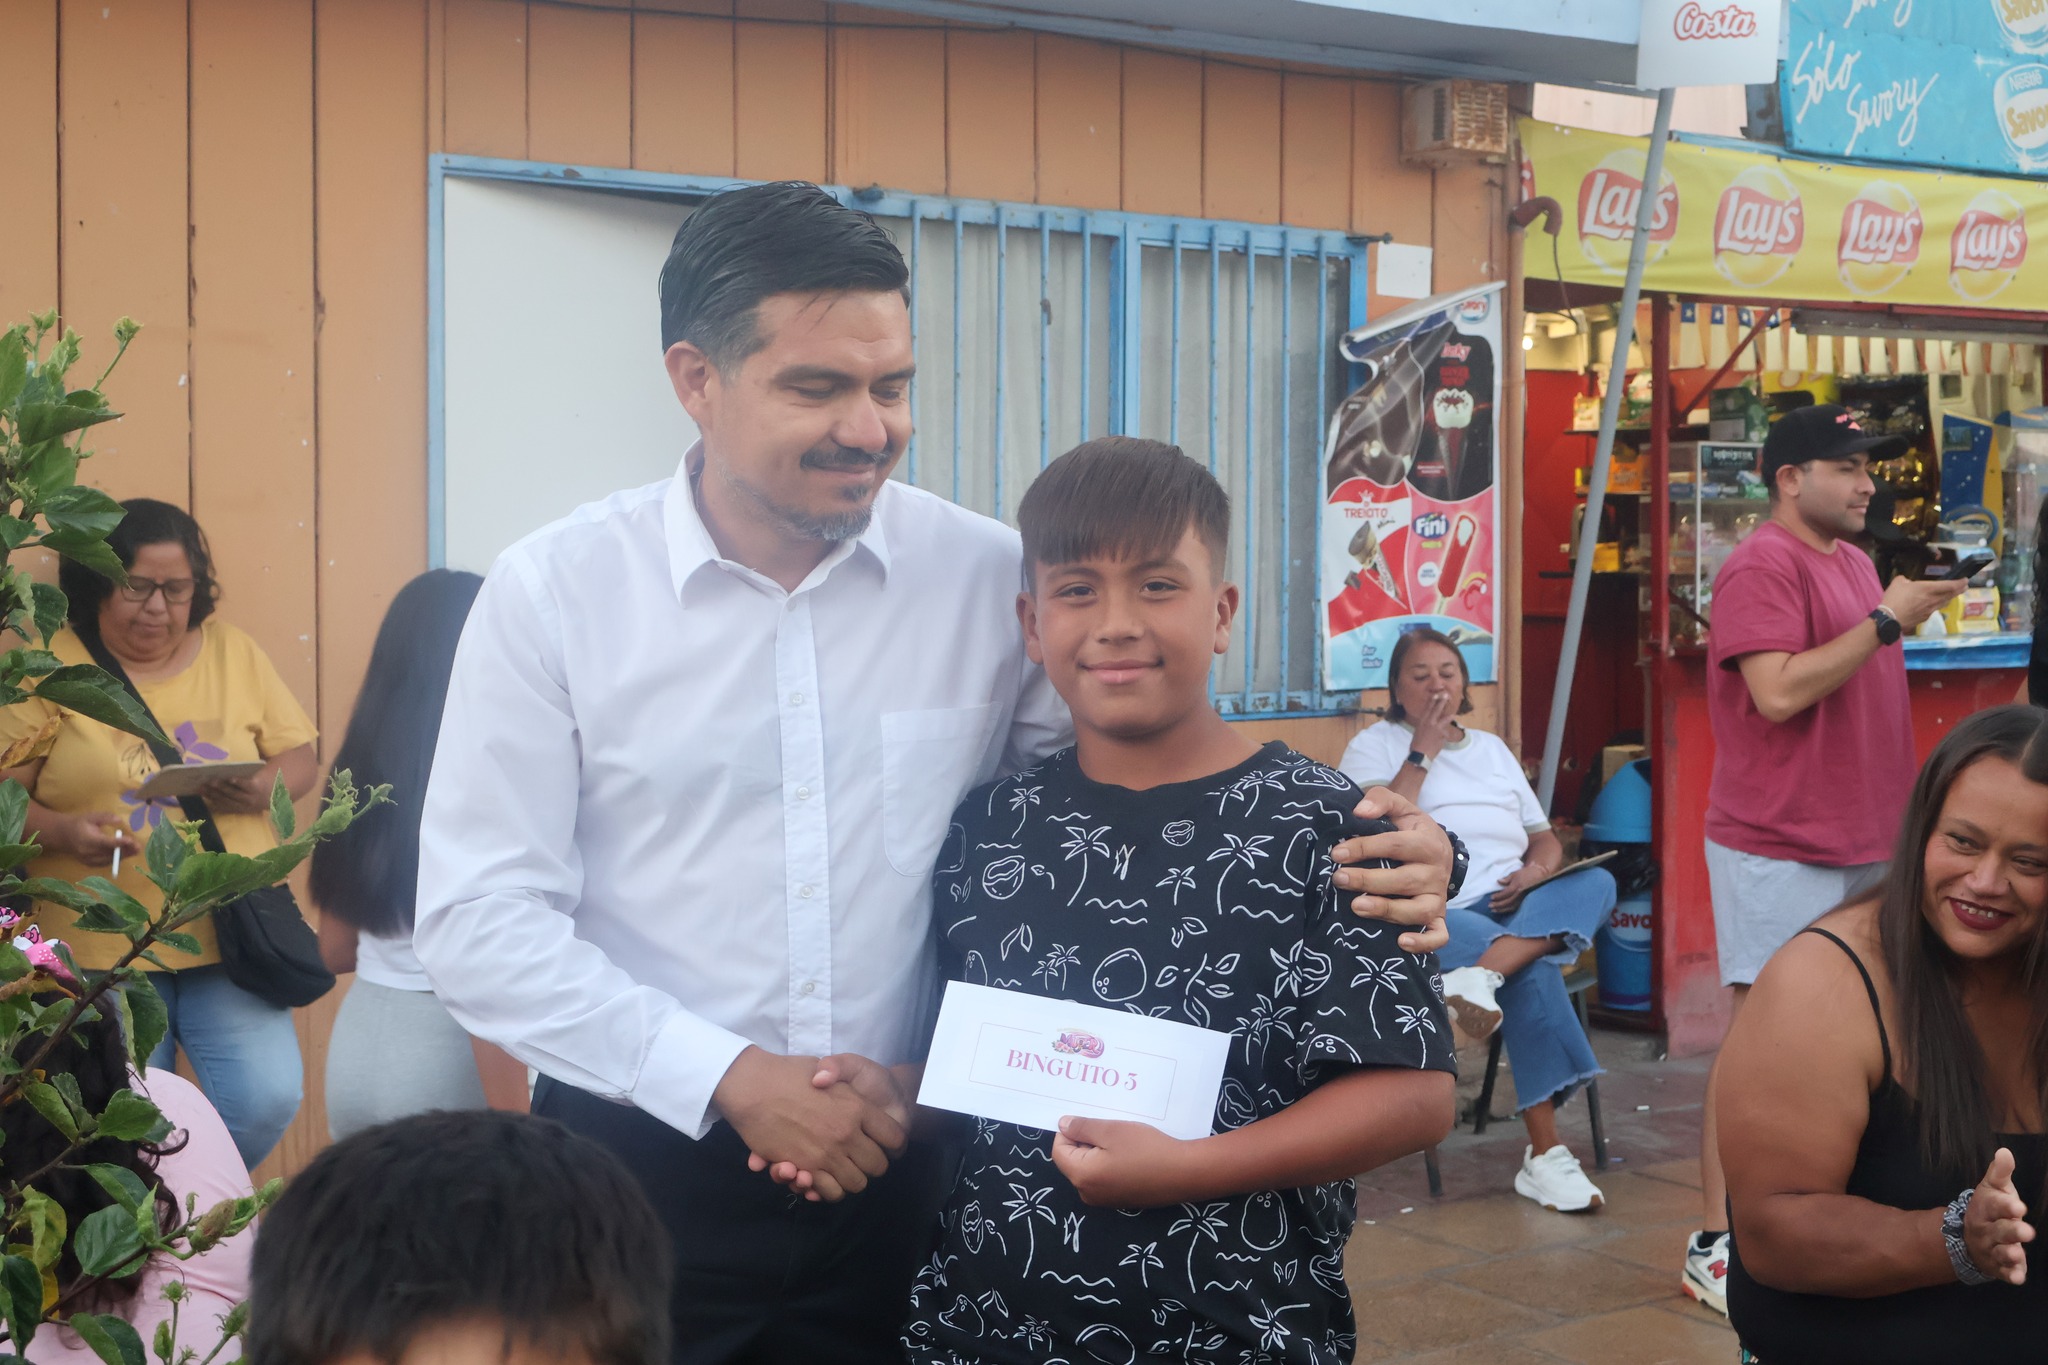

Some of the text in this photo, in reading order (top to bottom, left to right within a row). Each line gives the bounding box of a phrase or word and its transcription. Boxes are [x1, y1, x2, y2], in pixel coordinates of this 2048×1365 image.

[1673, 2, 1757, 41] Costa
[1845, 72, 1940, 156] Savory
[1415, 513, 1447, 537] Fini
[1006, 1049, 1120, 1087] BINGUITO
